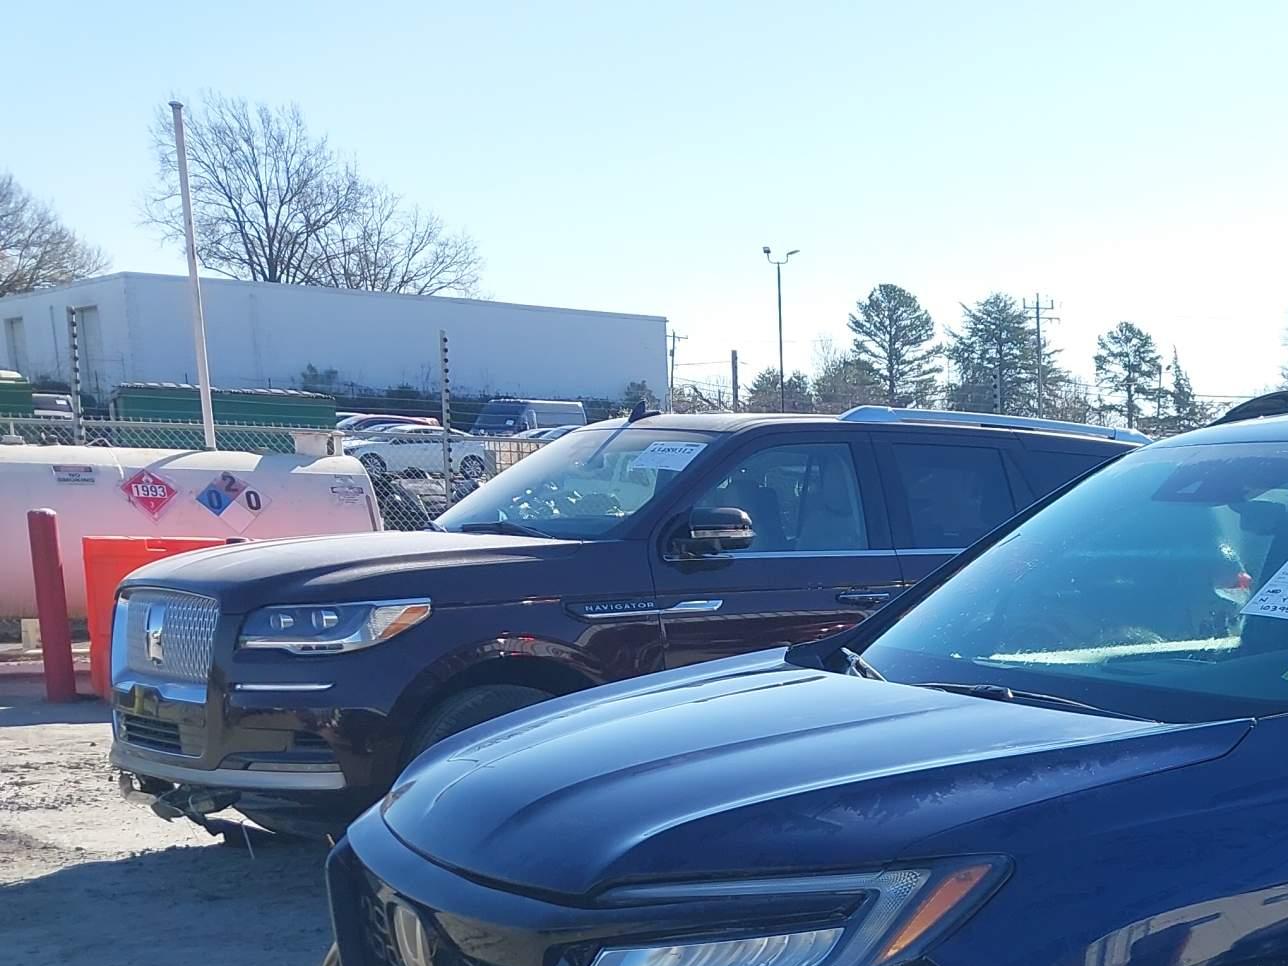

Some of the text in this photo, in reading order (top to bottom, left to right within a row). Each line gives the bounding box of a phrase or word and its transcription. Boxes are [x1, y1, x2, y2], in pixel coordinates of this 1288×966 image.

[222, 475, 238, 492] 2
[134, 485, 166, 498] 1993
[207, 489, 262, 511] 0 0
[585, 602, 654, 612] NAVIGATOR
